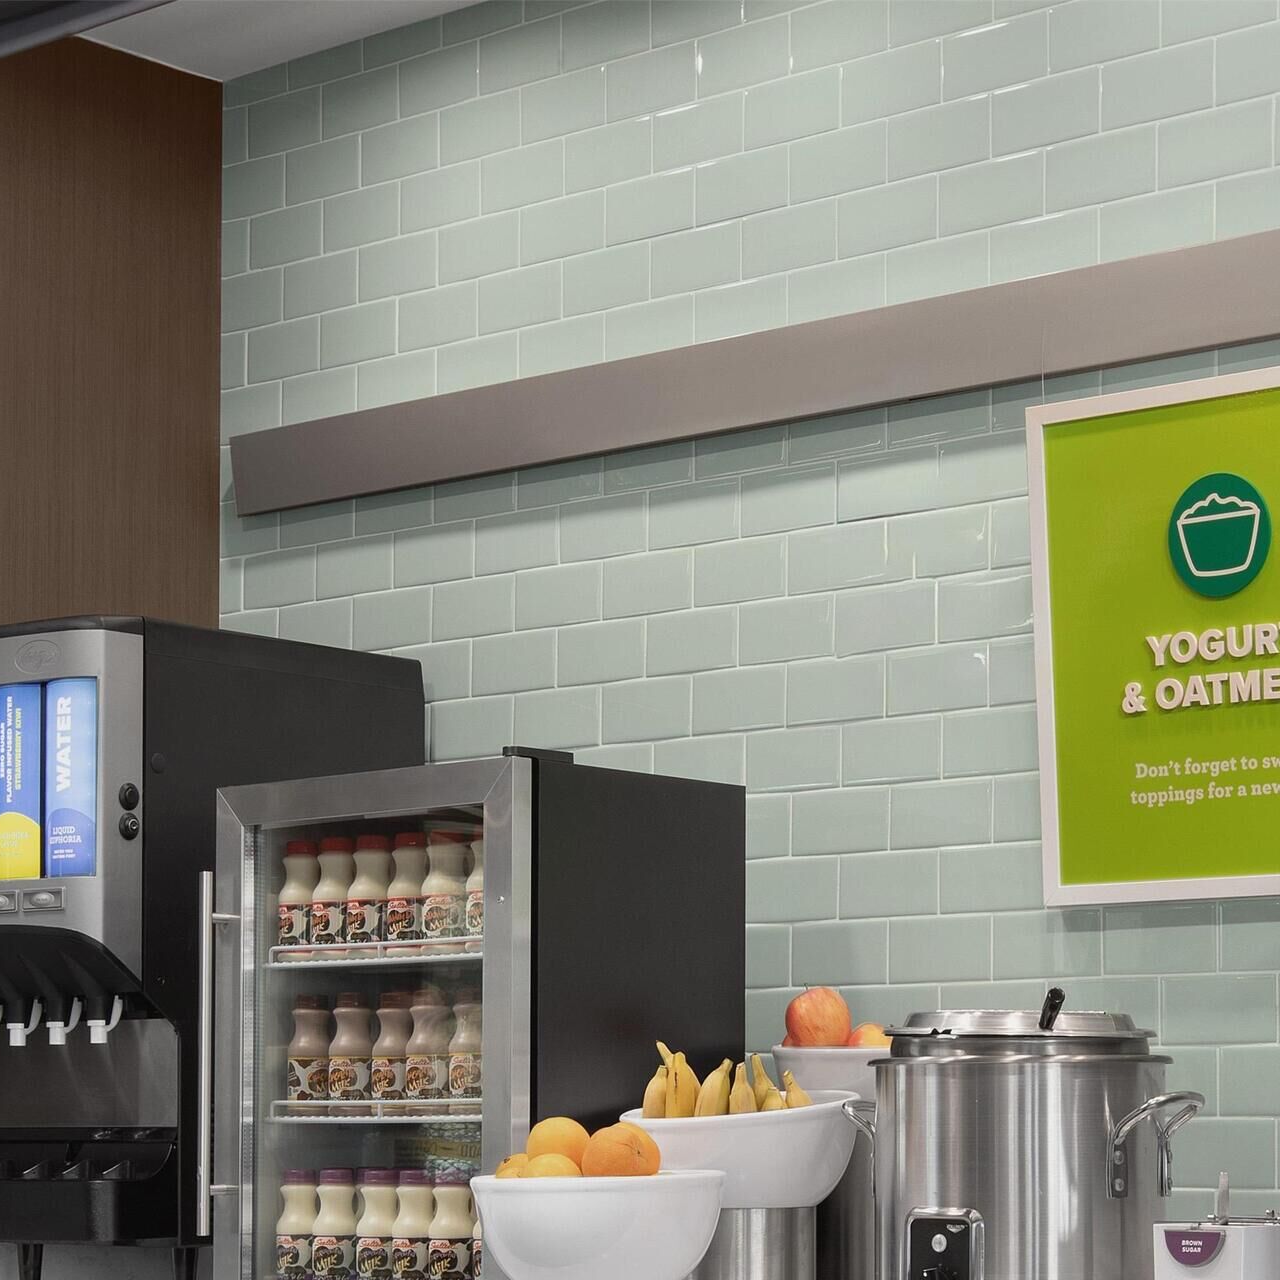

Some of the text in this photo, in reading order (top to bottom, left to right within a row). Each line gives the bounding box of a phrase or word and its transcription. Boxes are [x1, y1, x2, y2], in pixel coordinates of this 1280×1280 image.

[1121, 682, 1147, 714] &
[56, 696, 72, 792] WATER
[1184, 757, 1237, 777] forget
[1240, 756, 1258, 770] to
[1130, 785, 1204, 807] toppings
[1208, 782, 1233, 799] for
[1237, 785, 1247, 796] a
[52, 826, 76, 835] LIQUID
